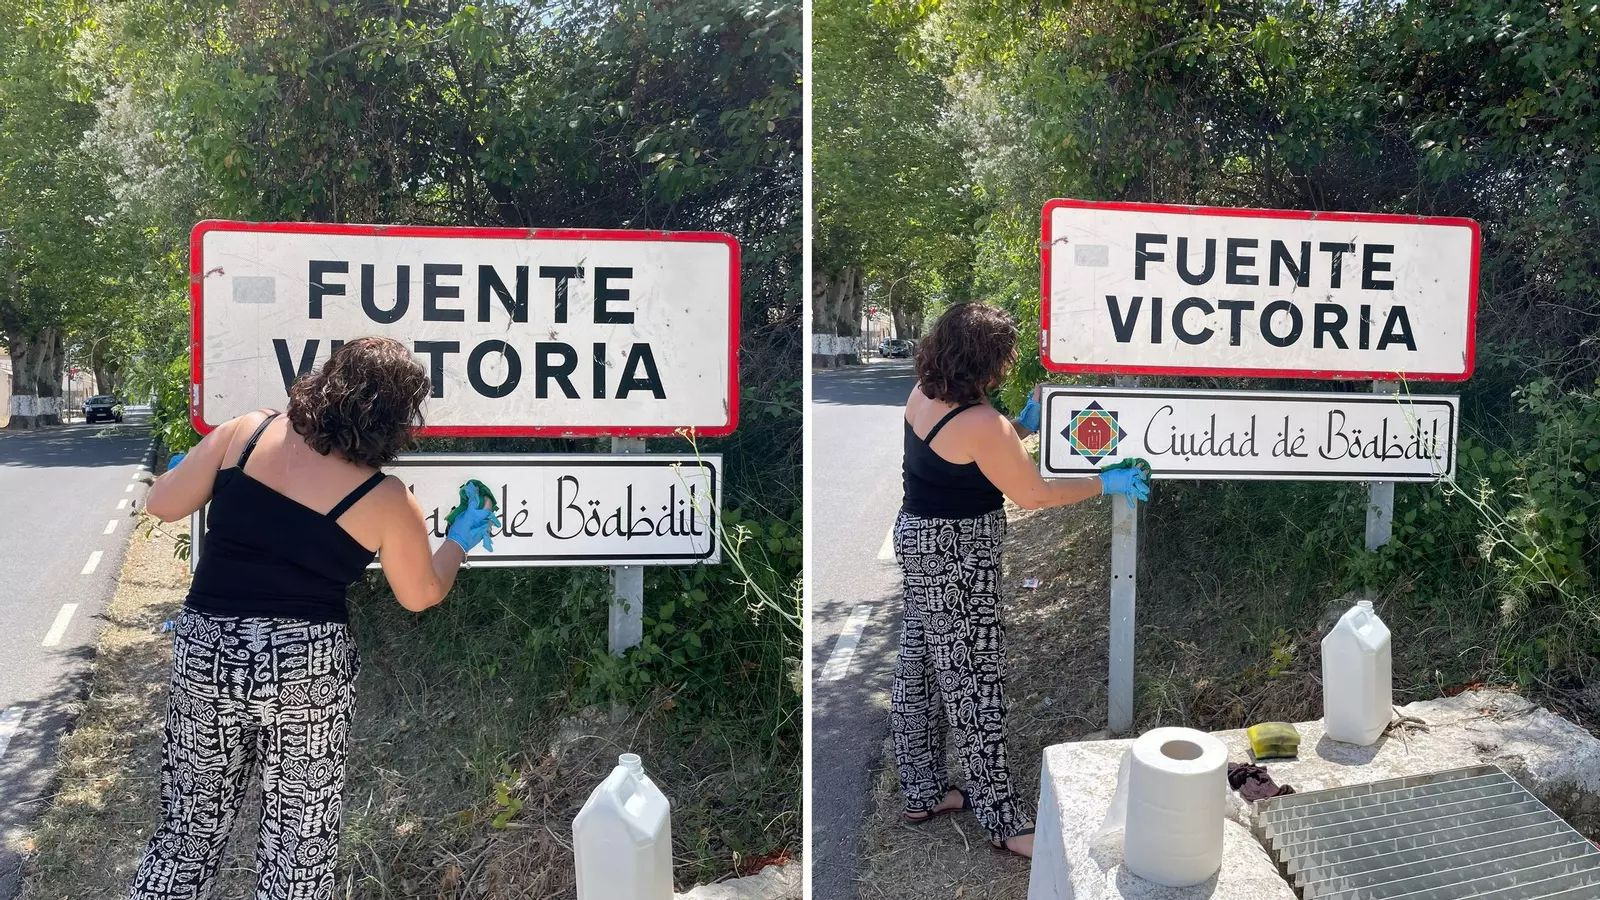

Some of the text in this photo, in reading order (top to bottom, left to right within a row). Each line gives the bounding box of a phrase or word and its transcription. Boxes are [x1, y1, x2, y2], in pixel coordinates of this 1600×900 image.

[1134, 232, 1395, 291] FUENTE
[308, 259, 635, 325] FUENTE
[1105, 294, 1418, 352] VICTORIA
[272, 338, 667, 401] VTORIA
[1143, 404, 1260, 463] Ciudad
